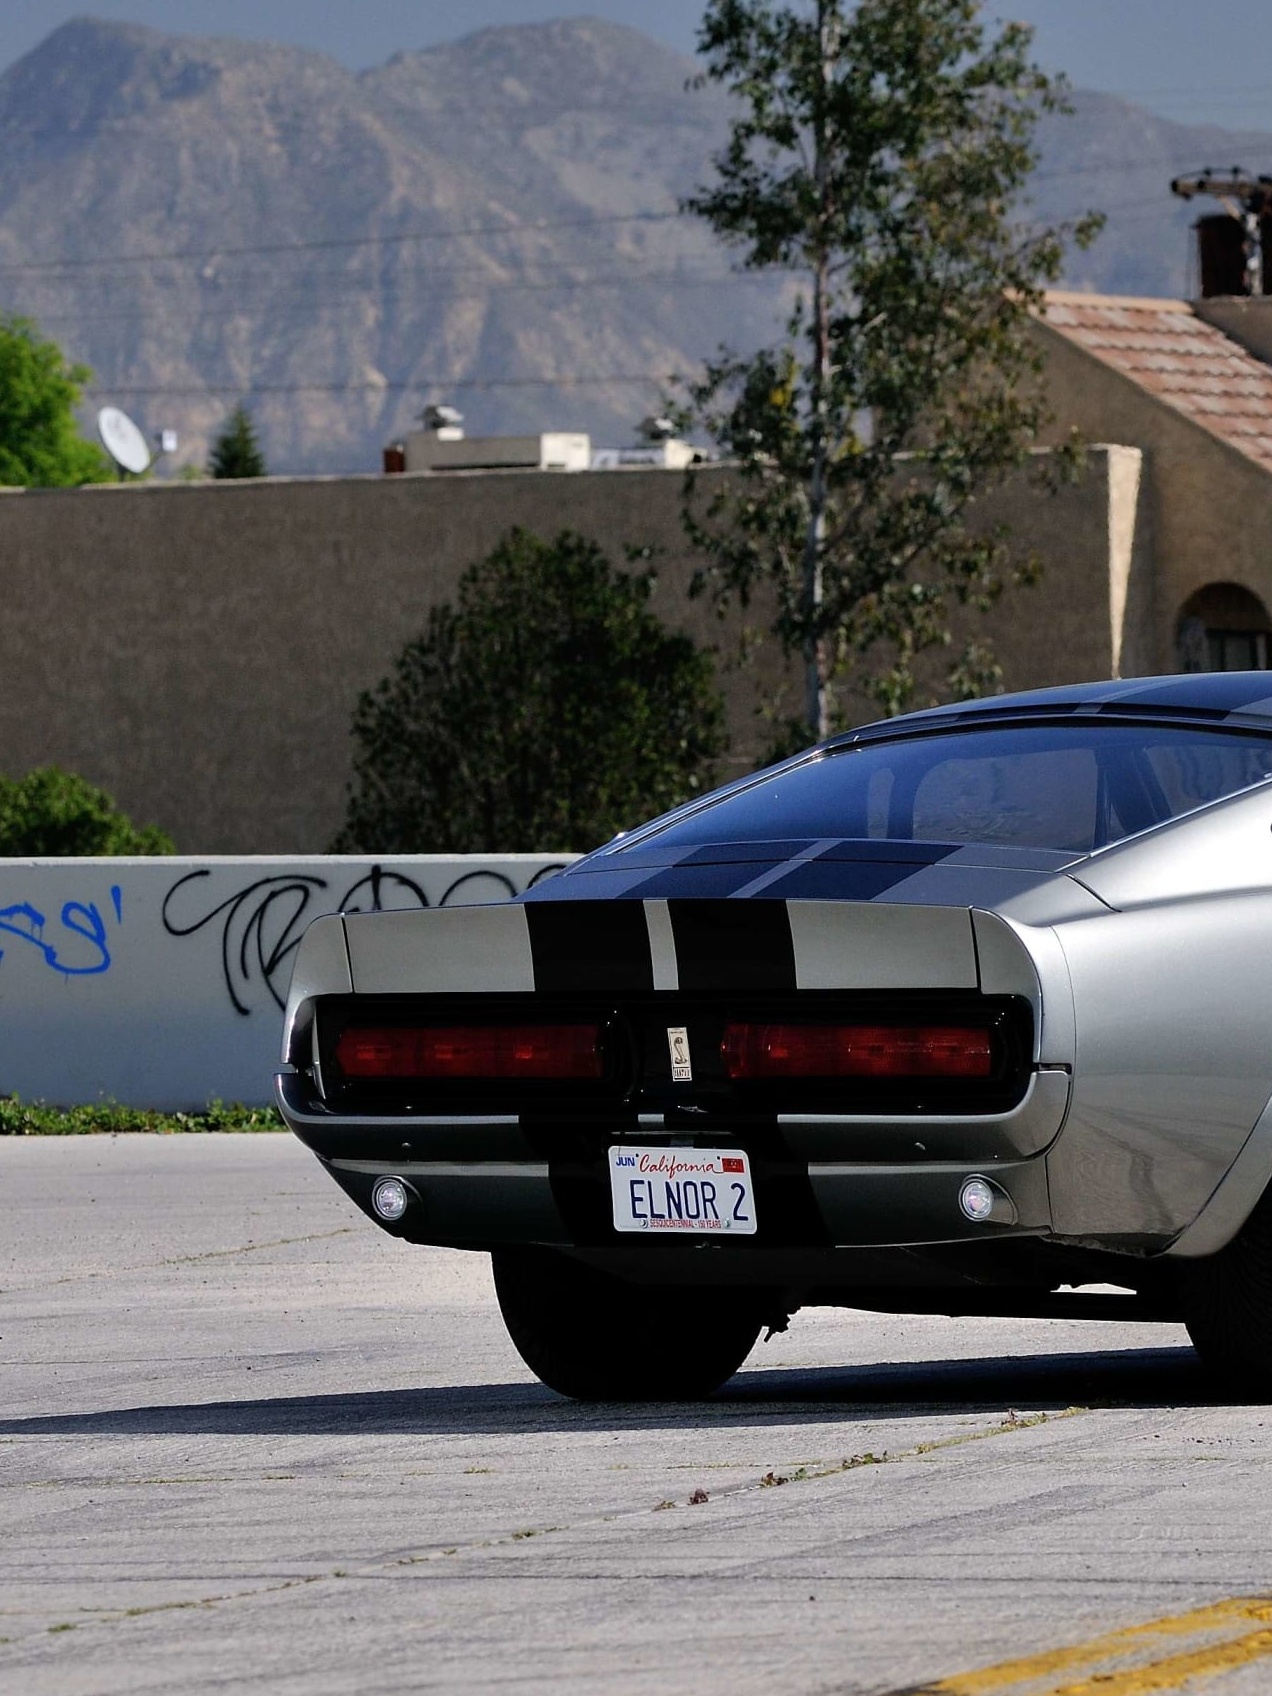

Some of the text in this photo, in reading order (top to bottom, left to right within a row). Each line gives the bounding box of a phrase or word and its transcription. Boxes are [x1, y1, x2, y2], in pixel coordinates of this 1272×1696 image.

[616, 1156, 635, 1167] JUN
[640, 1154, 724, 1179] California
[629, 1180, 748, 1221] ELNOR 2
[705, 1219, 721, 1229] YEARS
